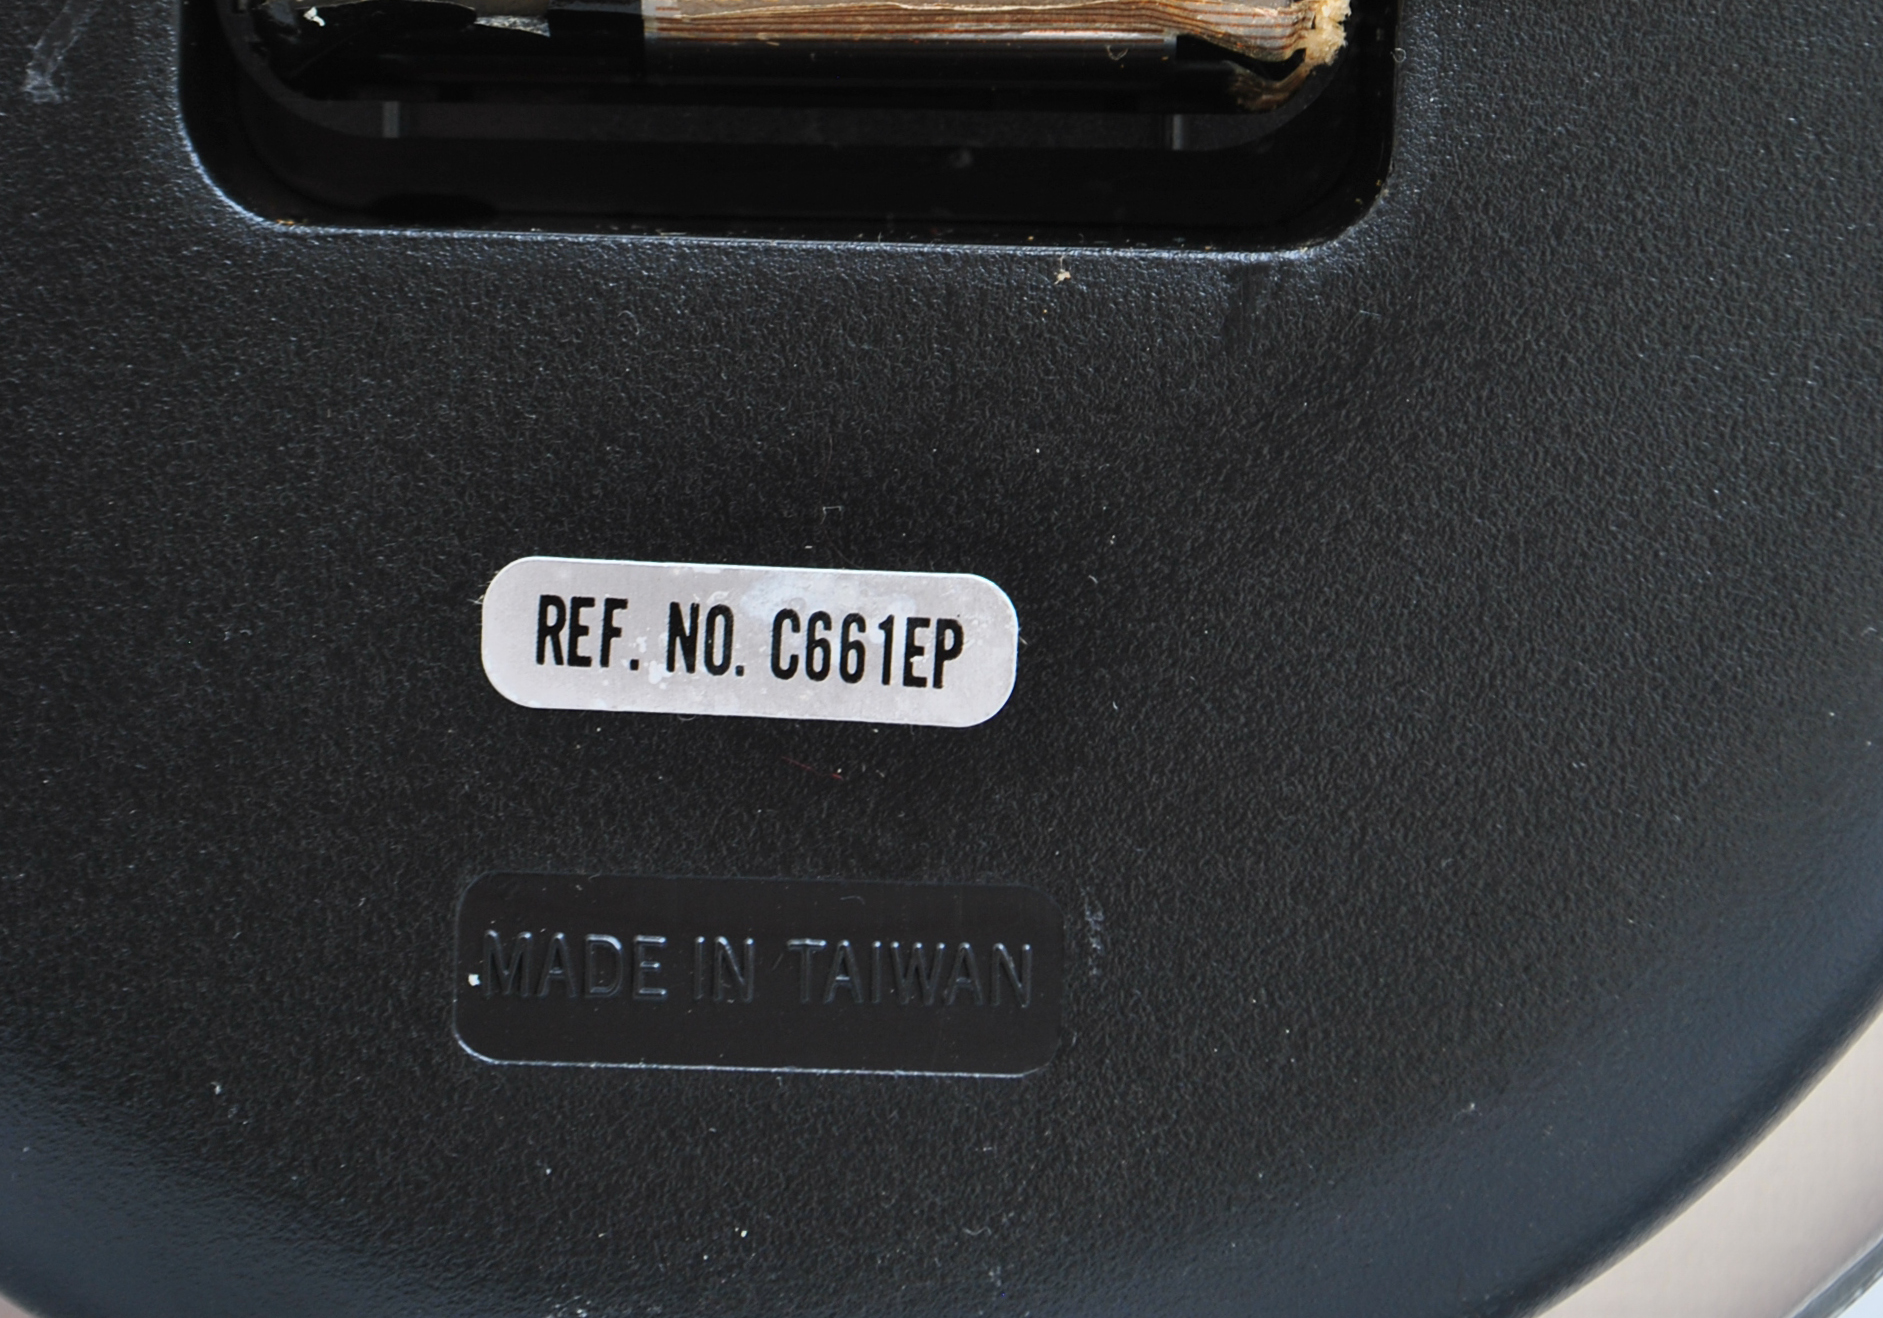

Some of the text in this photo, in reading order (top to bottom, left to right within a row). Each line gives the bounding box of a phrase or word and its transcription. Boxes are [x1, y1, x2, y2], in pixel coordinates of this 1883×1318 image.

[535, 593, 964, 689] REF. NO. C661EP
[483, 929, 1033, 1010] MADE IN TAIWAN
